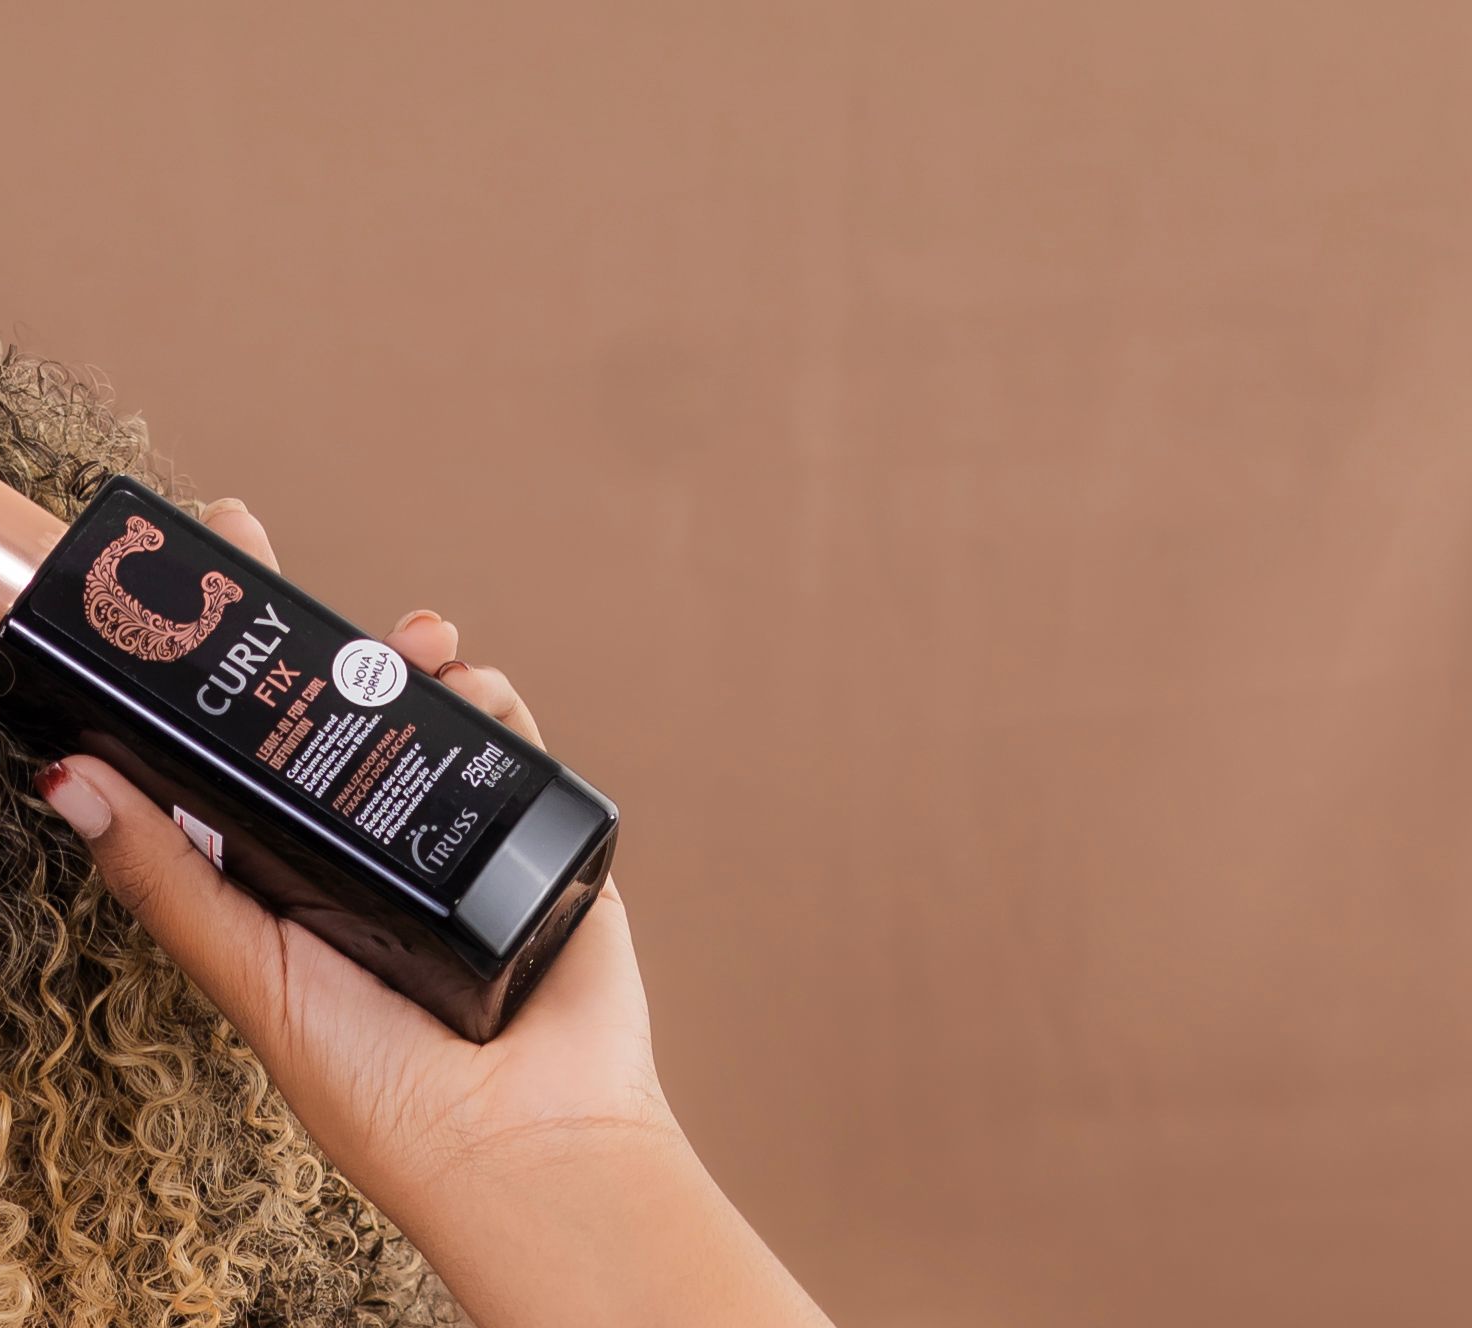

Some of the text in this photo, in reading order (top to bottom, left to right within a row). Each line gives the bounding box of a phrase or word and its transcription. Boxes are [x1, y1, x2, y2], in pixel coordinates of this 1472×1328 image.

[197, 603, 291, 715] CURLY
[253, 659, 302, 708] FIX
[353, 656, 373, 688] NOVA
[363, 652, 389, 702] FÓRMULA
[256, 677, 327, 762] LEAVE-IN FOR CURL
[268, 717, 314, 771] DEFINITION
[286, 713, 339, 780] Curl control and
[294, 712, 355, 785] Volume Reduction
[304, 715, 366, 792] Definition, Fixation
[314, 714, 383, 799] and Moisture Blocker.
[332, 728, 399, 811] FINALIZADOR PARA
[342, 723, 417, 817] FIXAÇÃO DOS CACHOS
[355, 742, 422, 826] Controle dos cachos e
[461, 741, 504, 788] 250ml
[363, 795, 393, 833] Redução
[391, 783, 402, 798] de
[372, 767, 430, 839] Definição, Fixação
[383, 745, 462, 845] e Bloqueador de Umidade.
[426, 807, 478, 867] TRUSS
